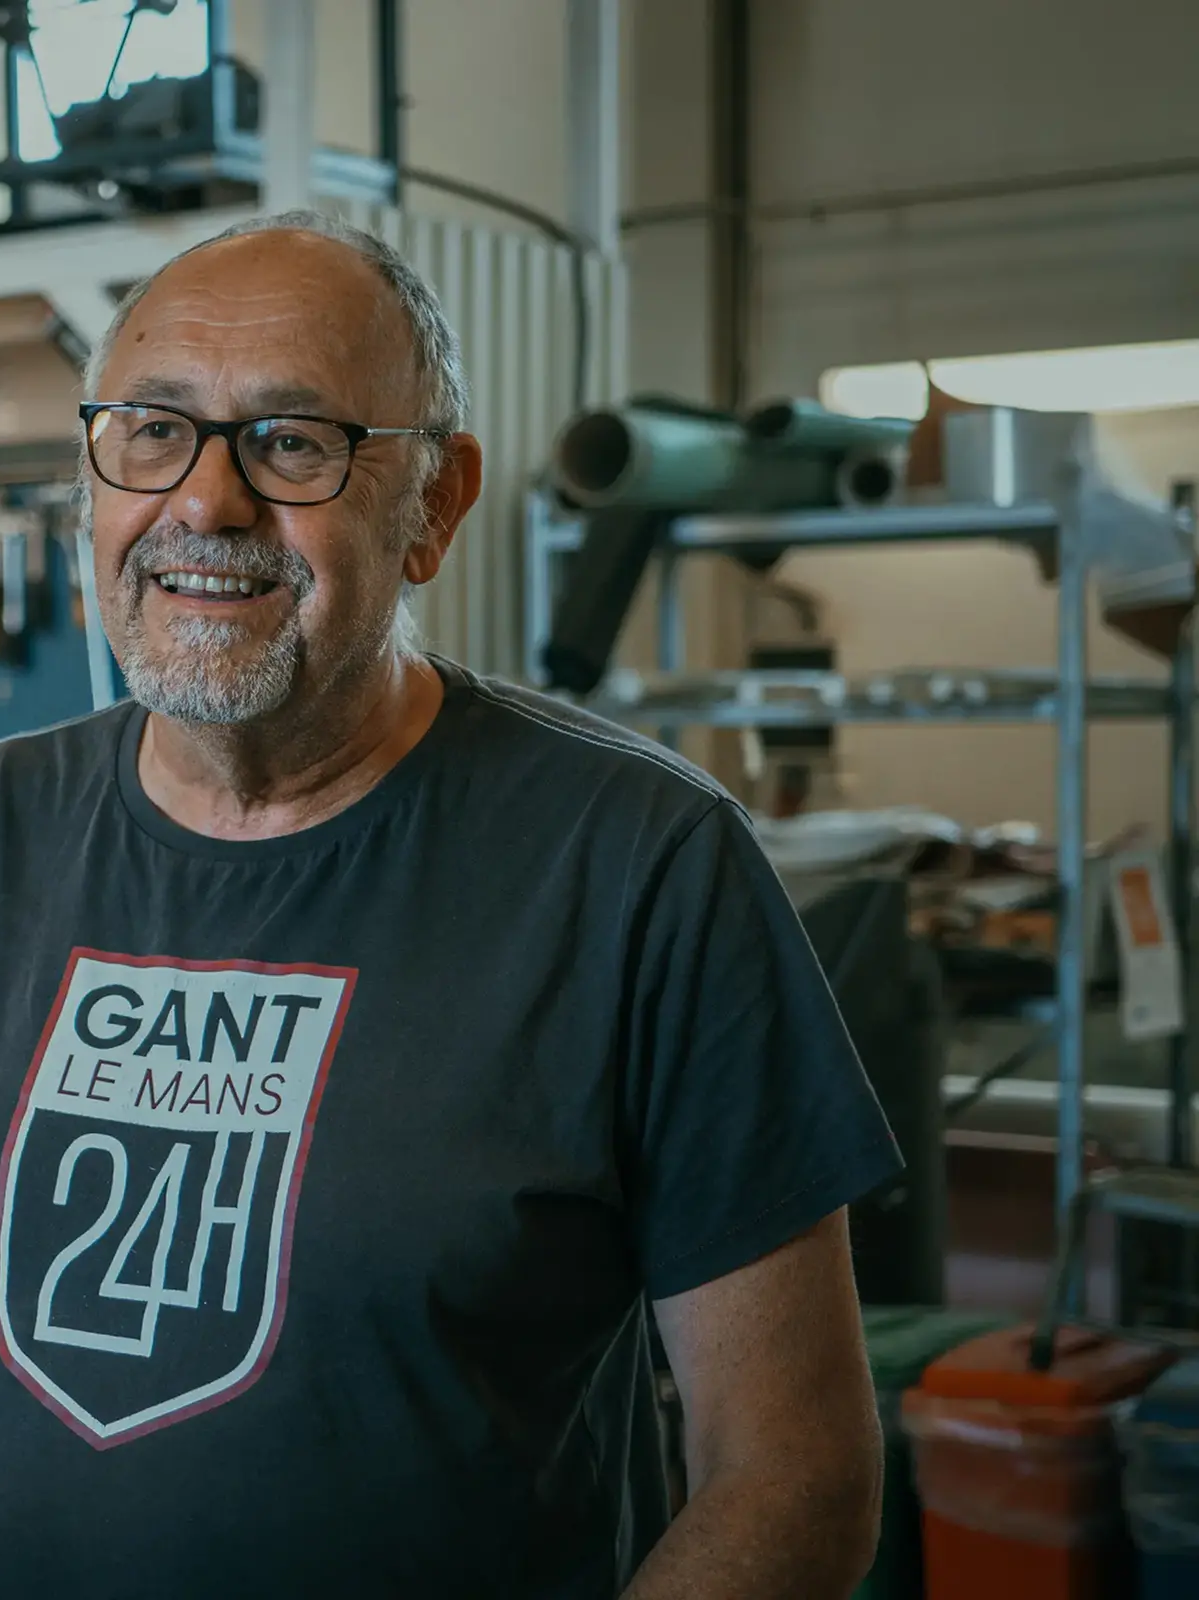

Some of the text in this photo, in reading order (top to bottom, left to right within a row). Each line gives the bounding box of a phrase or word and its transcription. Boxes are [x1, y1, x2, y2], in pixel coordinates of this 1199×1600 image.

[74, 984, 322, 1063] GANT
[57, 1054, 286, 1116] LE MANS
[34, 1130, 265, 1357] 24H
